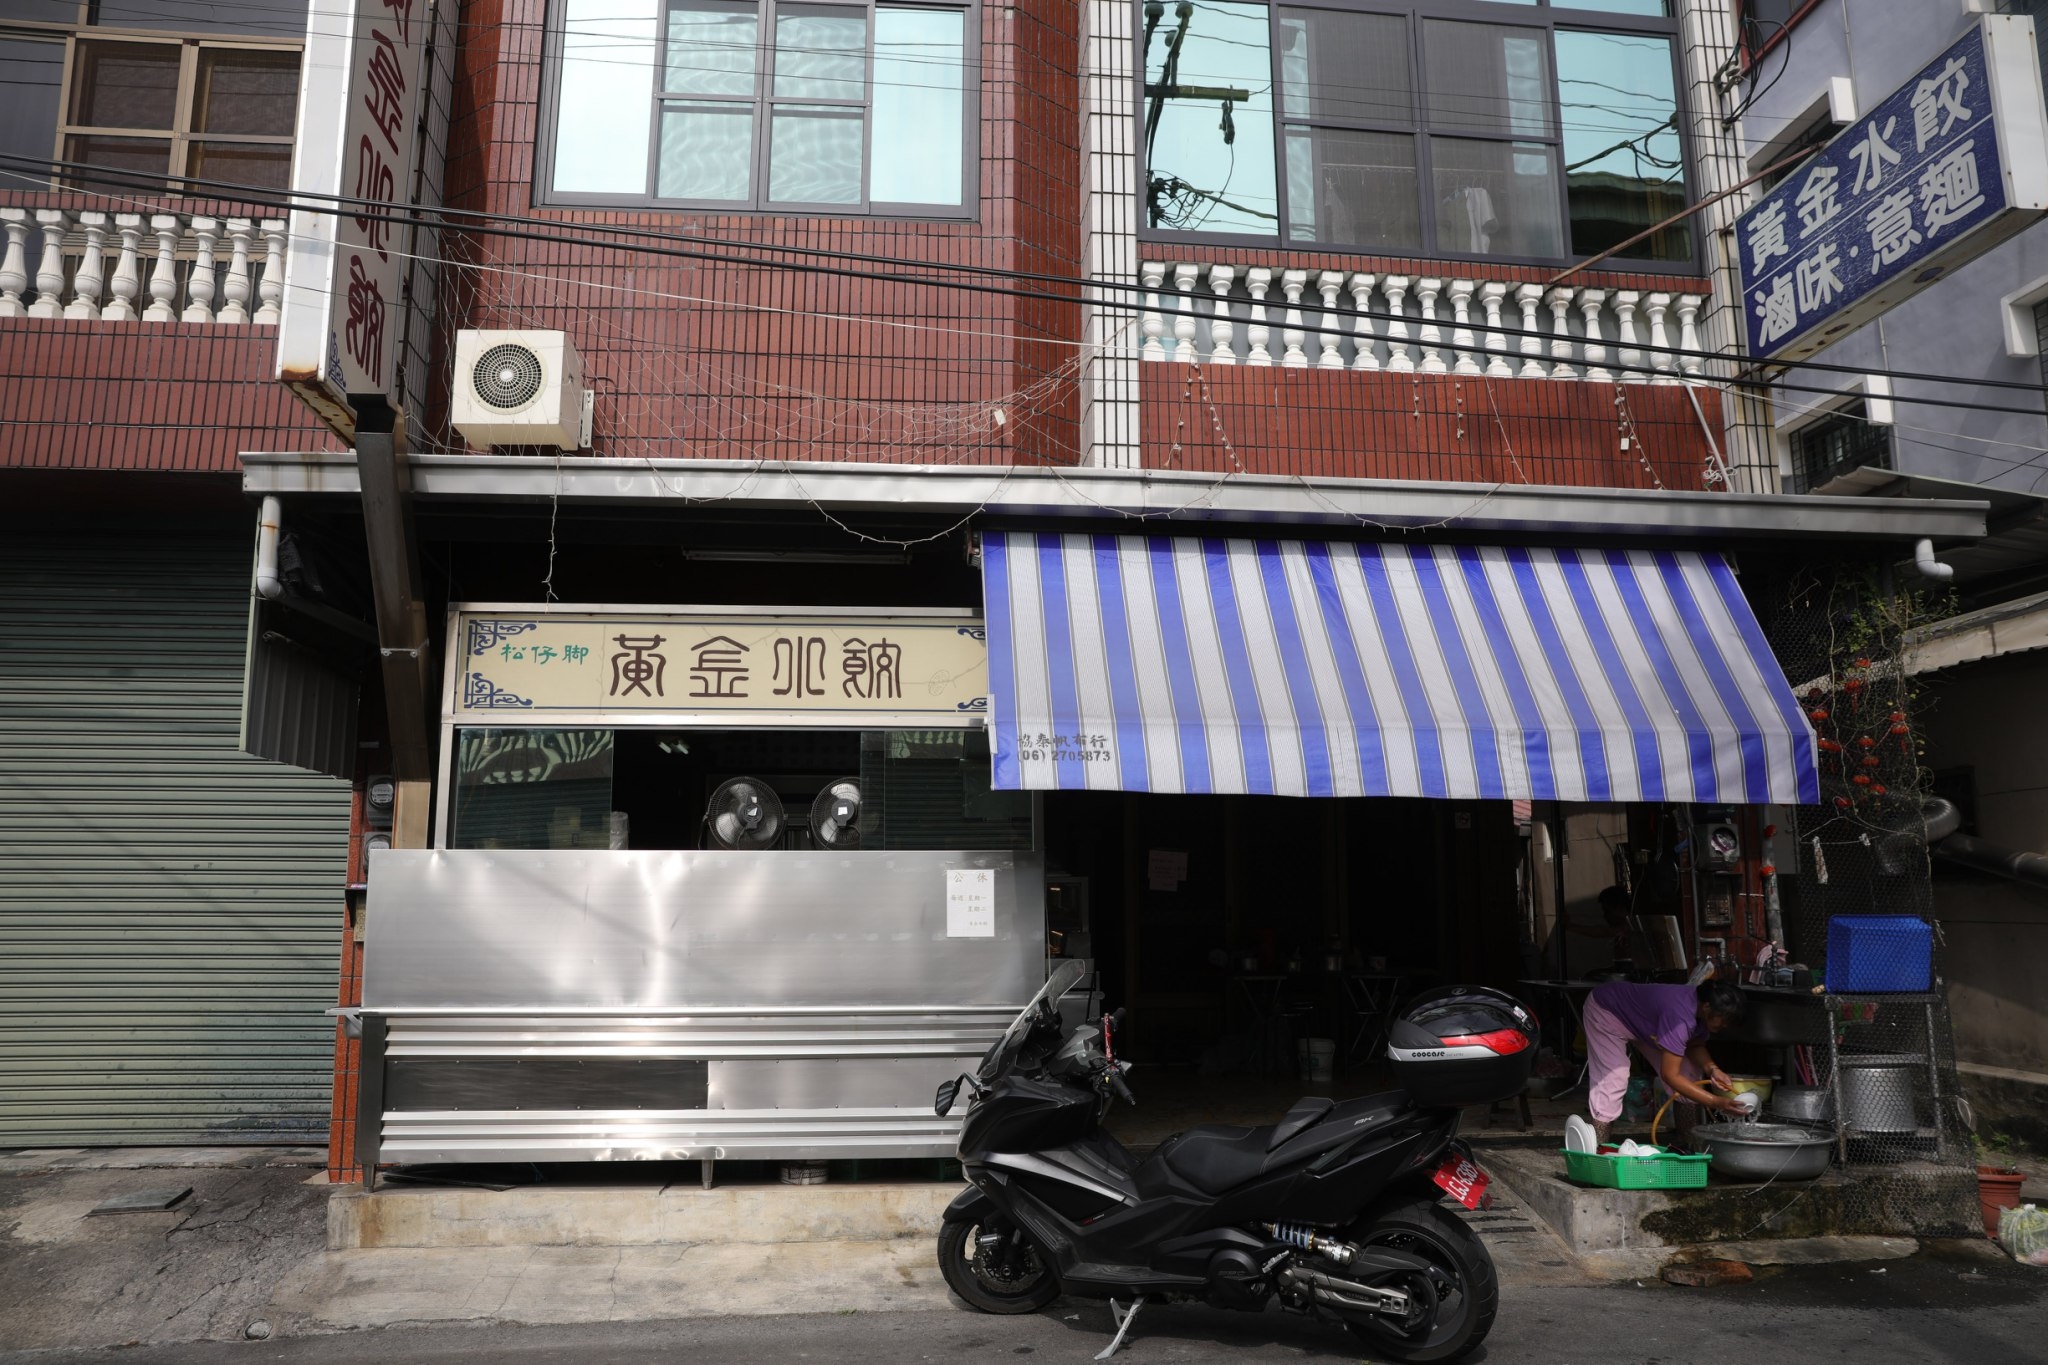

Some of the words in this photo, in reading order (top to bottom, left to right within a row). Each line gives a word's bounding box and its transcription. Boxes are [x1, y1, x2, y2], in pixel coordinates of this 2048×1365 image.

[1747, 55, 1972, 276] 黃金水餃
[1445, 1160, 1479, 1202] LGJ-6389
